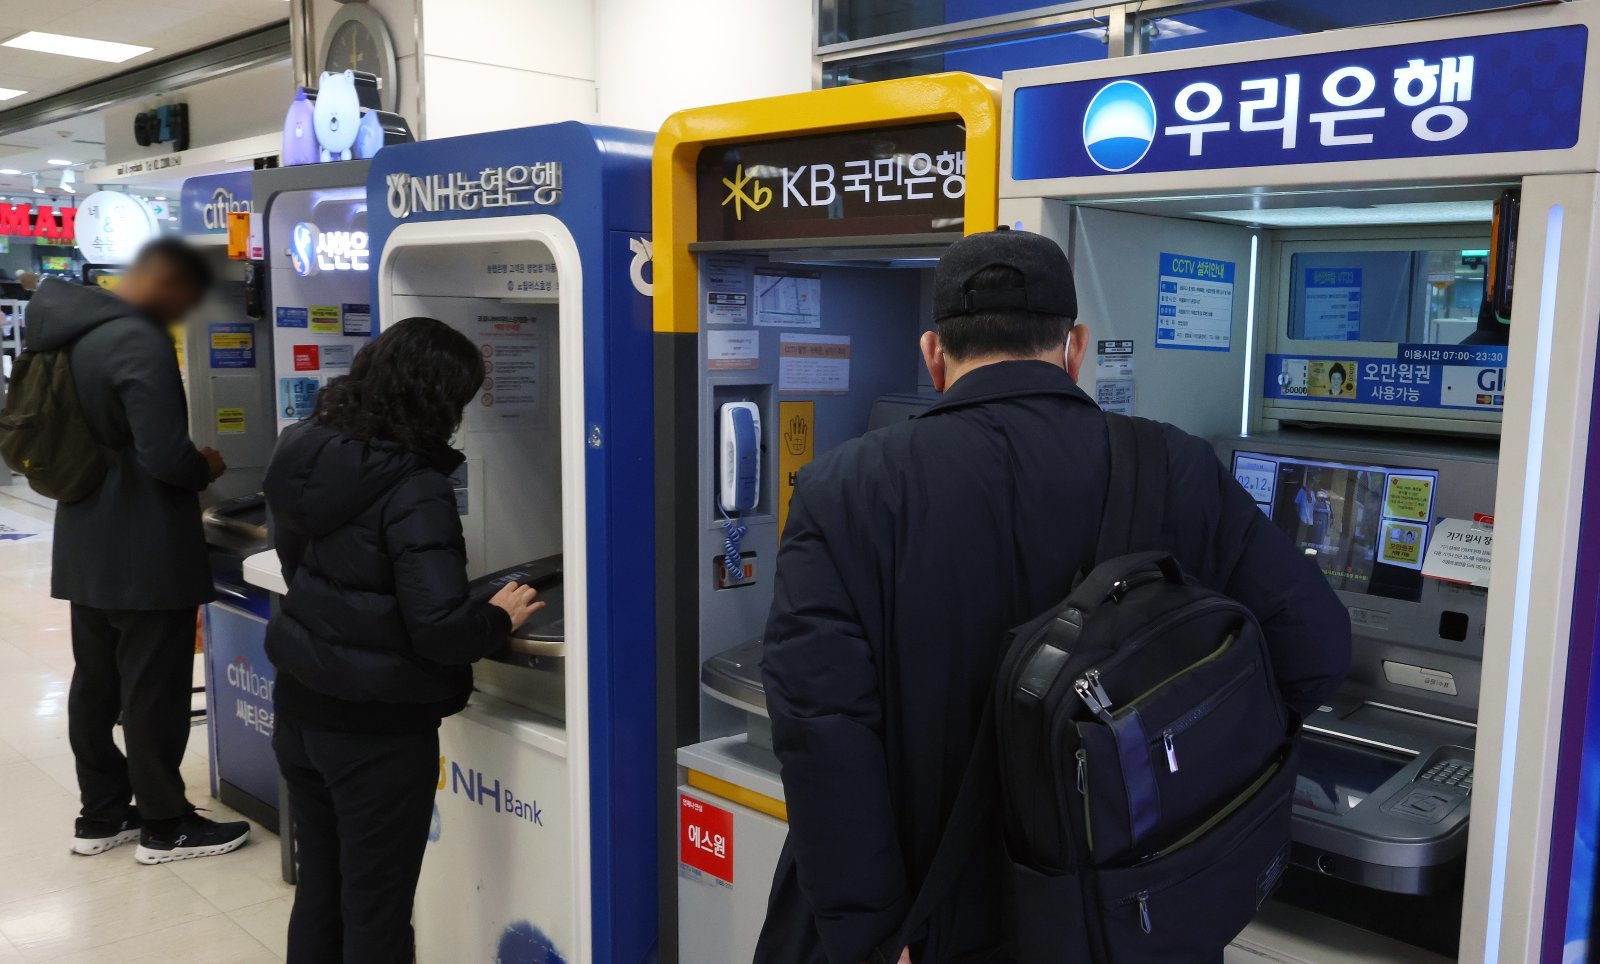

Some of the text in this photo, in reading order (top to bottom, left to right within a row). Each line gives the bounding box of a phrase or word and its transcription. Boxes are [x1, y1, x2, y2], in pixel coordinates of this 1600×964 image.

[1164, 55, 1475, 158] 우리은행
[411, 161, 563, 213] NH농협은행
[782, 151, 966, 208] KB 국민은행
[1172, 258, 1226, 279] CCTV 설치안내
[1404, 349, 1503, 363] 이용시간 07:00~23:30
[1363, 364, 1430, 388] 오만원권
[1477, 368, 1506, 392] Gl
[1371, 386, 1421, 403] 사용가능
[1447, 532, 1463, 541] 기기
[1465, 535, 1482, 544] 일시
[452, 760, 543, 827] NH Bank
[688, 823, 726, 860] 에스원
